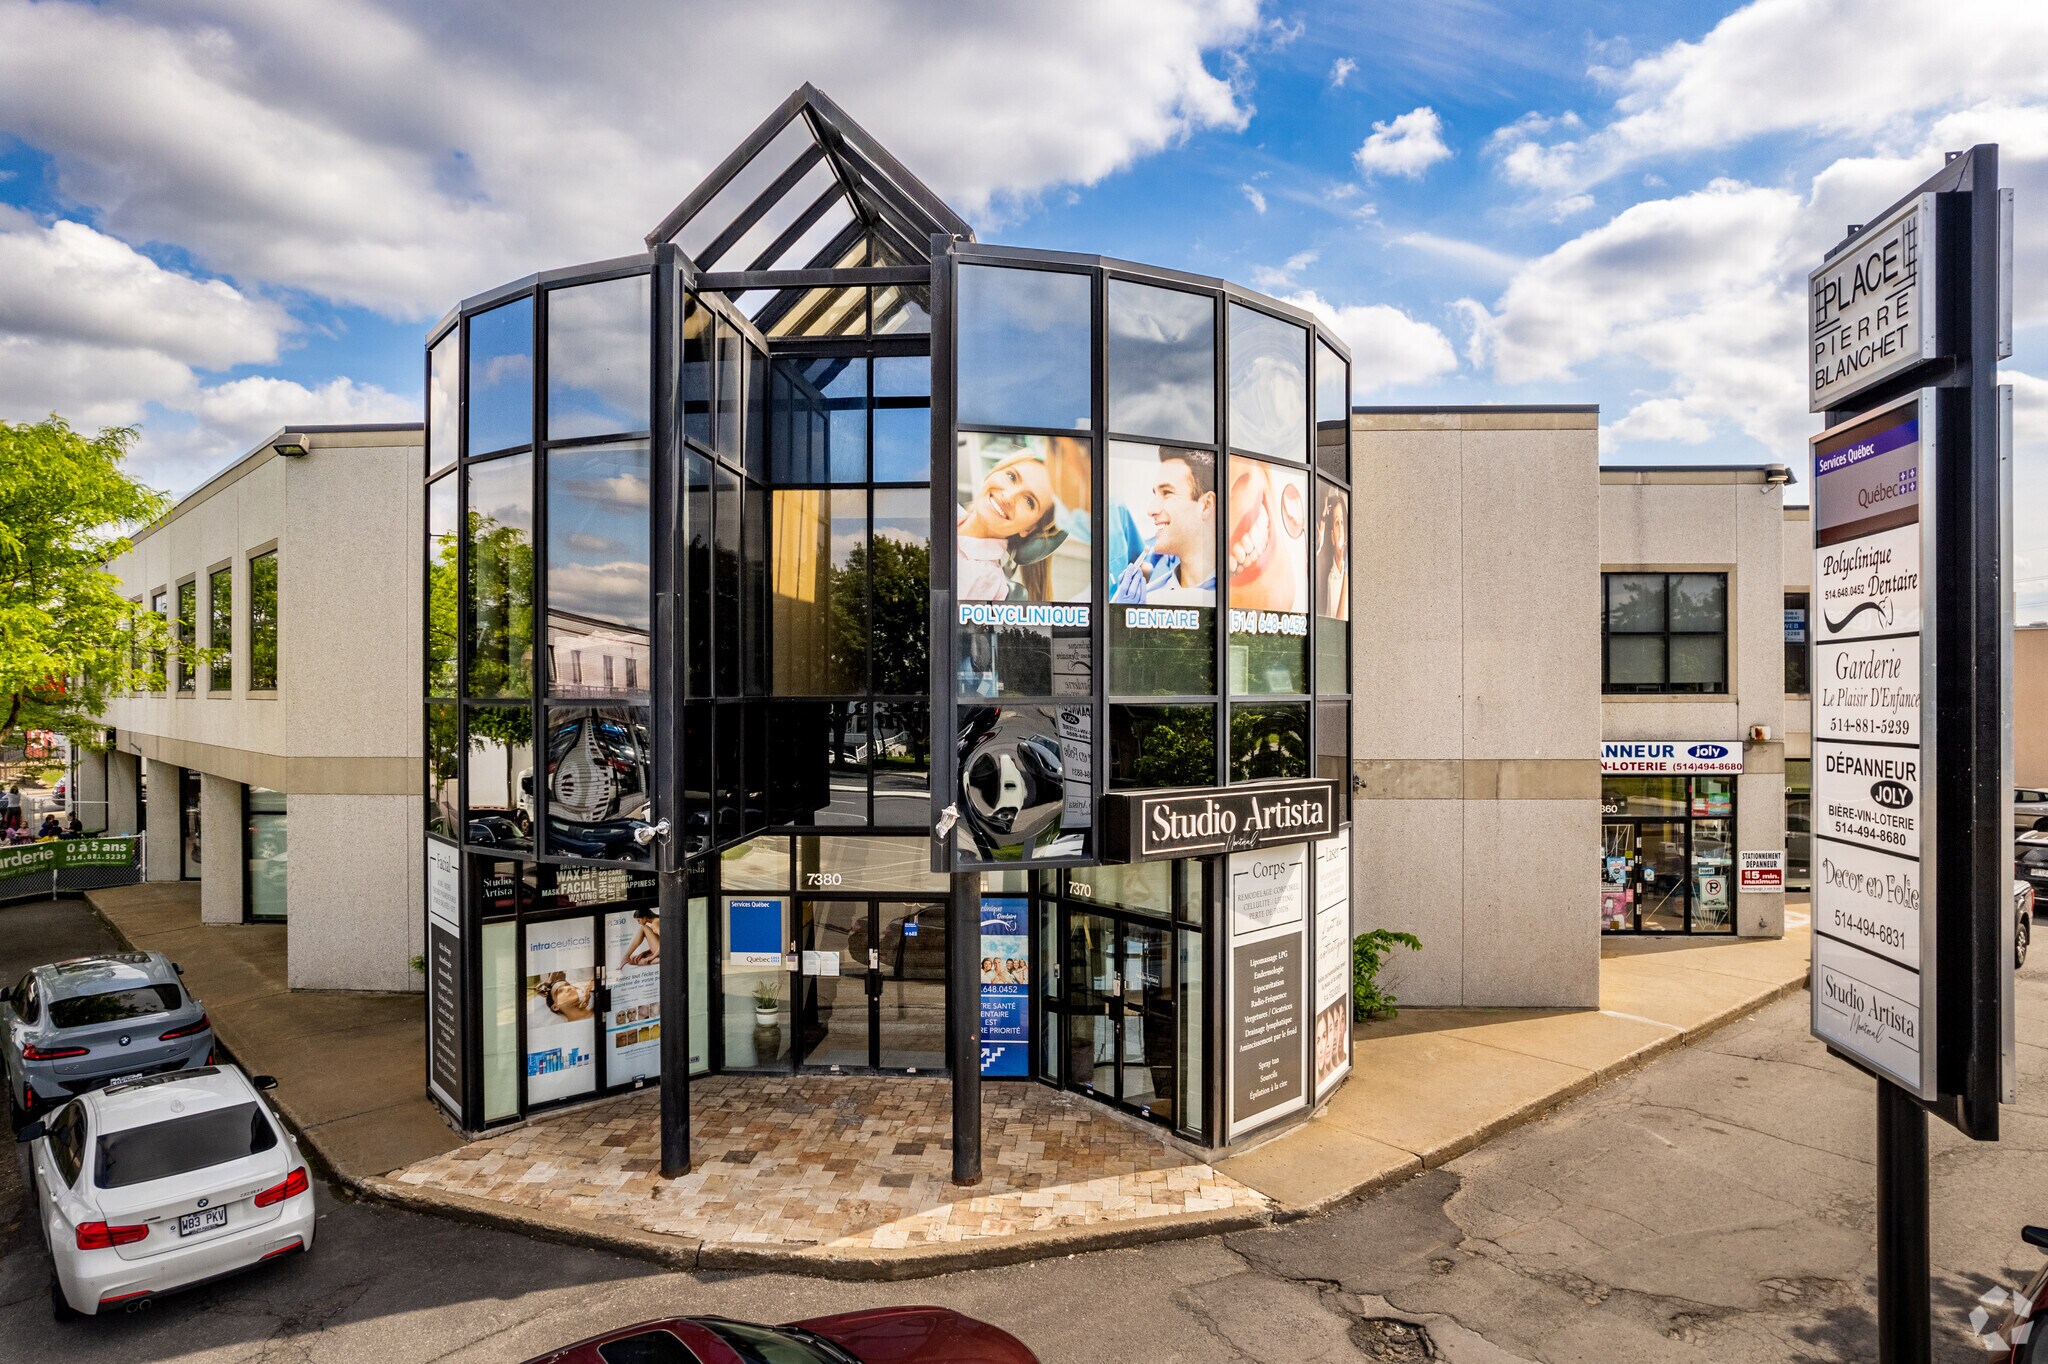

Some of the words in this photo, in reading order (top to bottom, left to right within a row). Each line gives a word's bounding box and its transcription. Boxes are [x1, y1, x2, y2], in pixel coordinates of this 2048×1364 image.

[1824, 238, 1899, 319] PLACE
[1815, 292, 1909, 364] PIERRE
[1815, 323, 1909, 390] BLANCHET
[1819, 453, 1847, 473] Services
[1848, 443, 1875, 464] Québec
[1858, 482, 1898, 508] Québec
[1823, 546, 1892, 580] Polyclinique
[1825, 584, 1865, 600] 514.648.0452
[1868, 569, 1918, 597] Dentaire
[960, 605, 1088, 625] POLYCLINIQUE
[1127, 610, 1198, 628] DENTAIRE
[1259, 614, 1306, 634] 648-0452
[1836, 649, 1901, 680] Garderie
[1823, 688, 1834, 707] Le
[1837, 687, 1868, 707] Plaisir
[1871, 687, 1920, 714] D'Enfance
[1830, 718, 1909, 735] 514-881-5239
[1695, 745, 1720, 758] joly
[1826, 752, 1916, 781] DÉPANNEUR
[1875, 785, 1908, 806] JOLY
[1152, 799, 1237, 842] Studio
[1243, 796, 1324, 831] Artista
[1828, 803, 1914, 831] BIÈRE-VIN-LOTERIE
[1835, 822, 1906, 846] 514-494-8680
[91, 841, 99, 852] 5
[102, 843, 127, 852] ans
[556, 869, 580, 882] WAX
[1253, 861, 1286, 879] Corps
[484, 877, 512, 886] Studio
[561, 880, 597, 895] FACIAL
[621, 879, 656, 889] HAPPINESS
[807, 873, 842, 886] 7380
[1823, 858, 1863, 893] Decor
[1866, 876, 1883, 899] en
[1886, 874, 1919, 910] Folie
[483, 888, 513, 898] Artista
[568, 892, 597, 902] WAXING
[1068, 881, 1092, 898] 7370
[1834, 910, 1905, 949] 514-494-6831
[530, 936, 590, 952] intraceuticals
[746, 955, 770, 964] Québec
[1278, 950, 1288, 960] LPG
[992, 1001, 1016, 1010] SANTÉ
[1825, 974, 1864, 1013] Studio
[1868, 996, 1914, 1039] Artista
[989, 1026, 1021, 1035] PRIORITÉ
[206, 1210, 223, 1224] PKV
